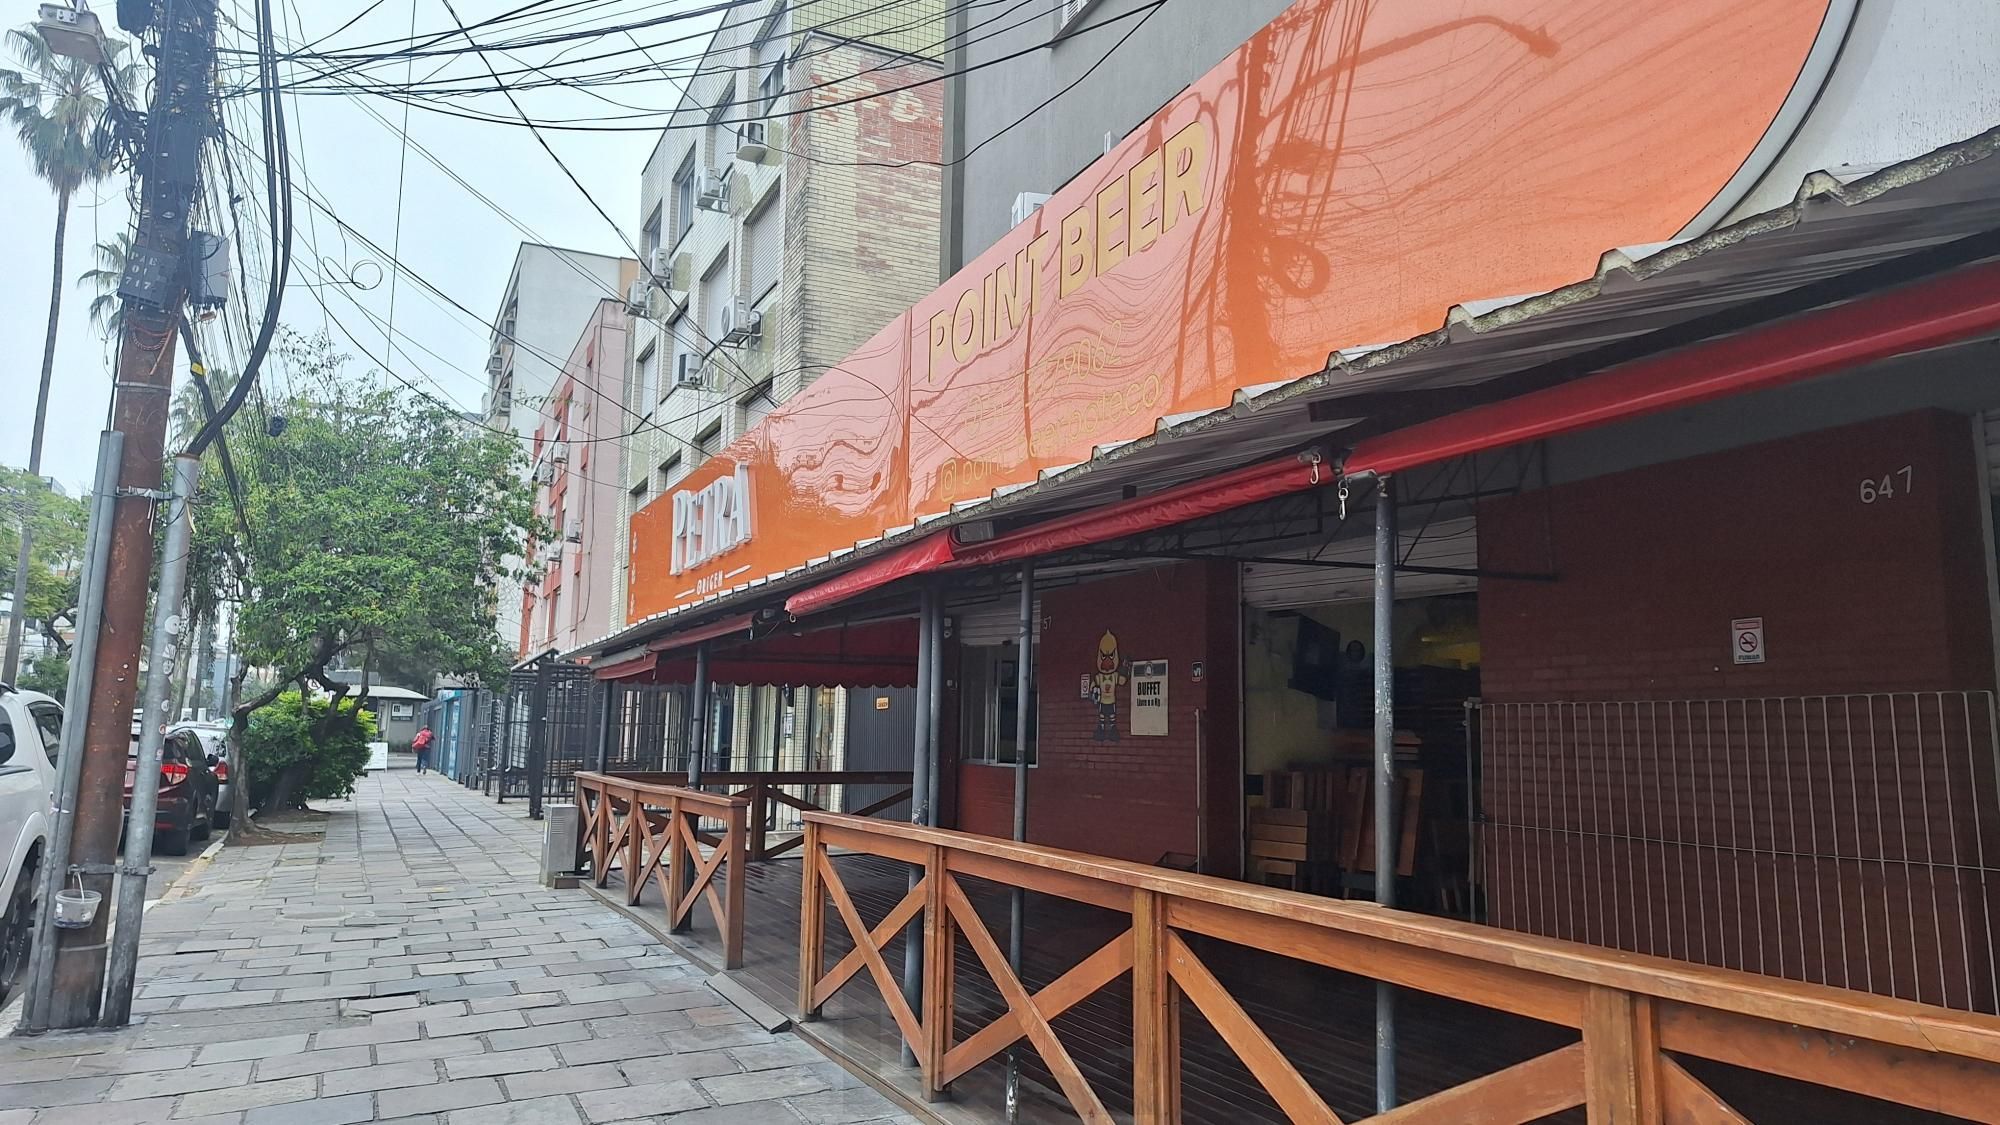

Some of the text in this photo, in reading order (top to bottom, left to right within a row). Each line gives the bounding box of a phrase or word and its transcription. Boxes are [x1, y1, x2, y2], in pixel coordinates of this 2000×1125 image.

[929, 120, 1204, 384] POINT BEER
[670, 462, 752, 576] PETRA
[1860, 465, 1912, 503] 647
[1137, 681, 1160, 696] BUFFET
